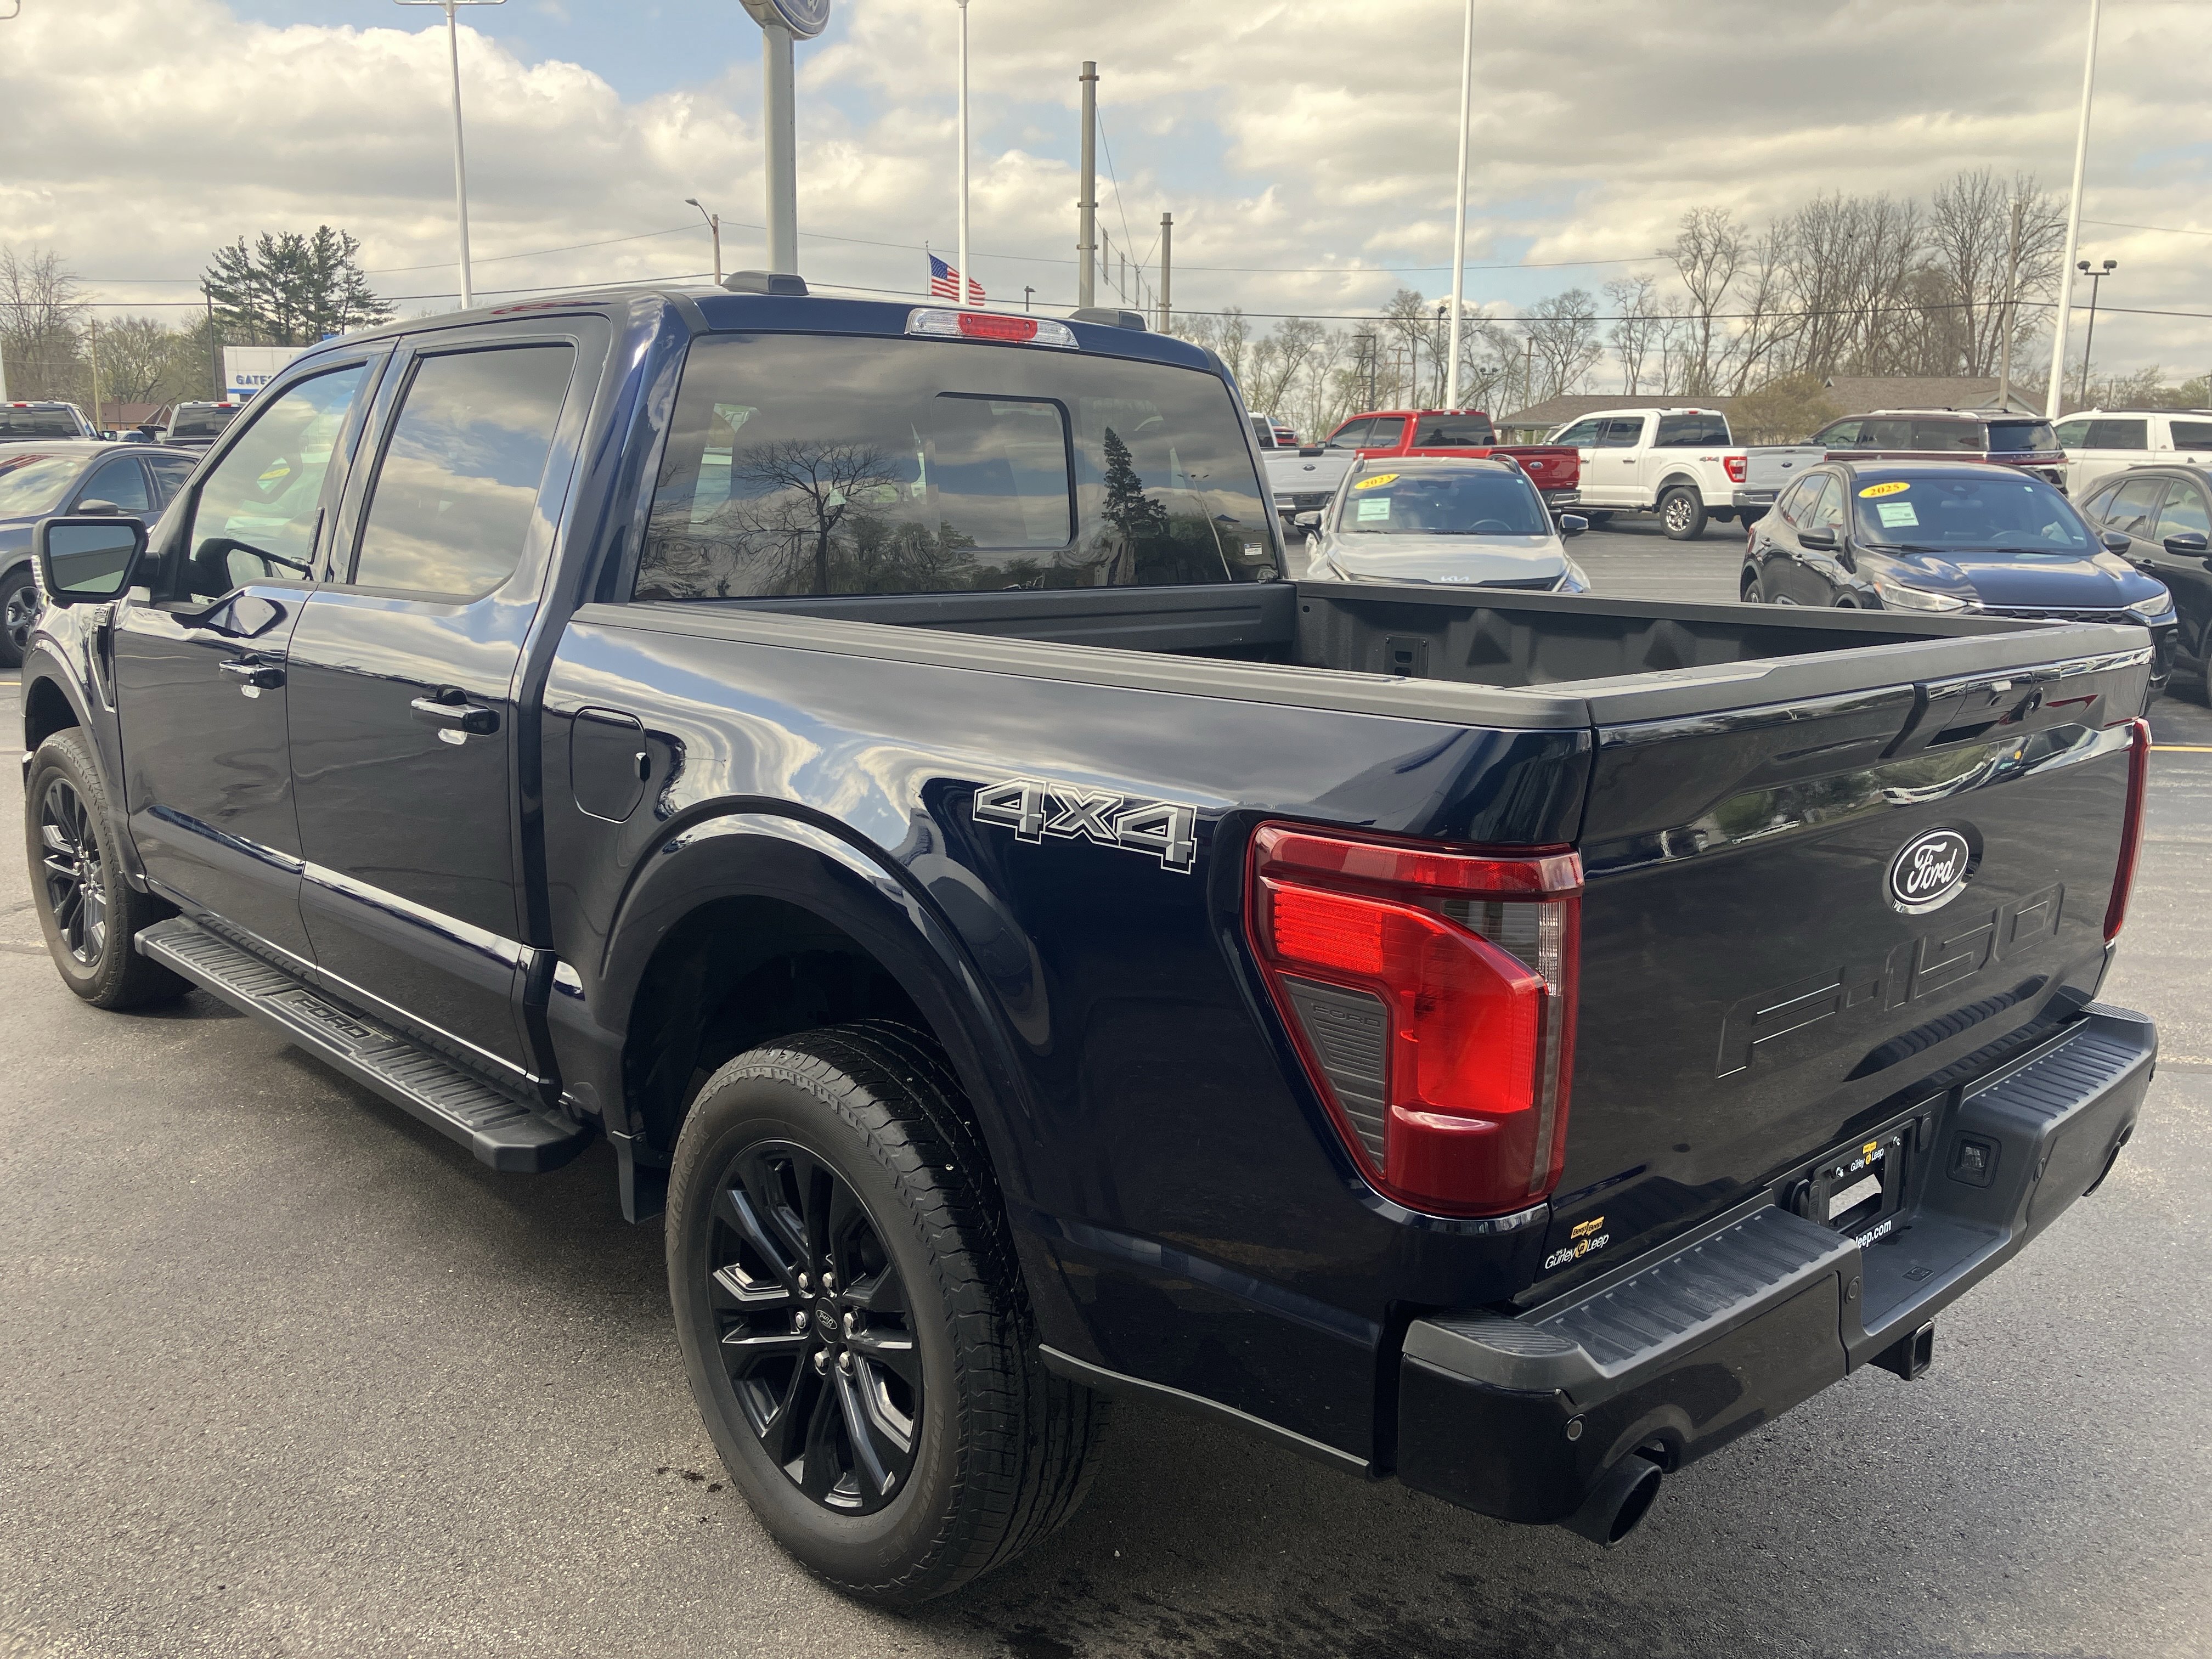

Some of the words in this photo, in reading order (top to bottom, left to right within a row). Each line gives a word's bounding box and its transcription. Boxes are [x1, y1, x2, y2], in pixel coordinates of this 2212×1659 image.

[1364, 476, 1391, 487] 2023
[1870, 484, 1899, 495] 2025
[1907, 841, 1958, 894] Ford
[1716, 883, 2065, 1079] F-150
[288, 998, 373, 1039] FORD
[1311, 1003, 1381, 1029] FORD
[1545, 1248, 1577, 1269] Gurley
[1586, 1233, 1609, 1252] Leep
[819, 1312, 833, 1327] Ford
